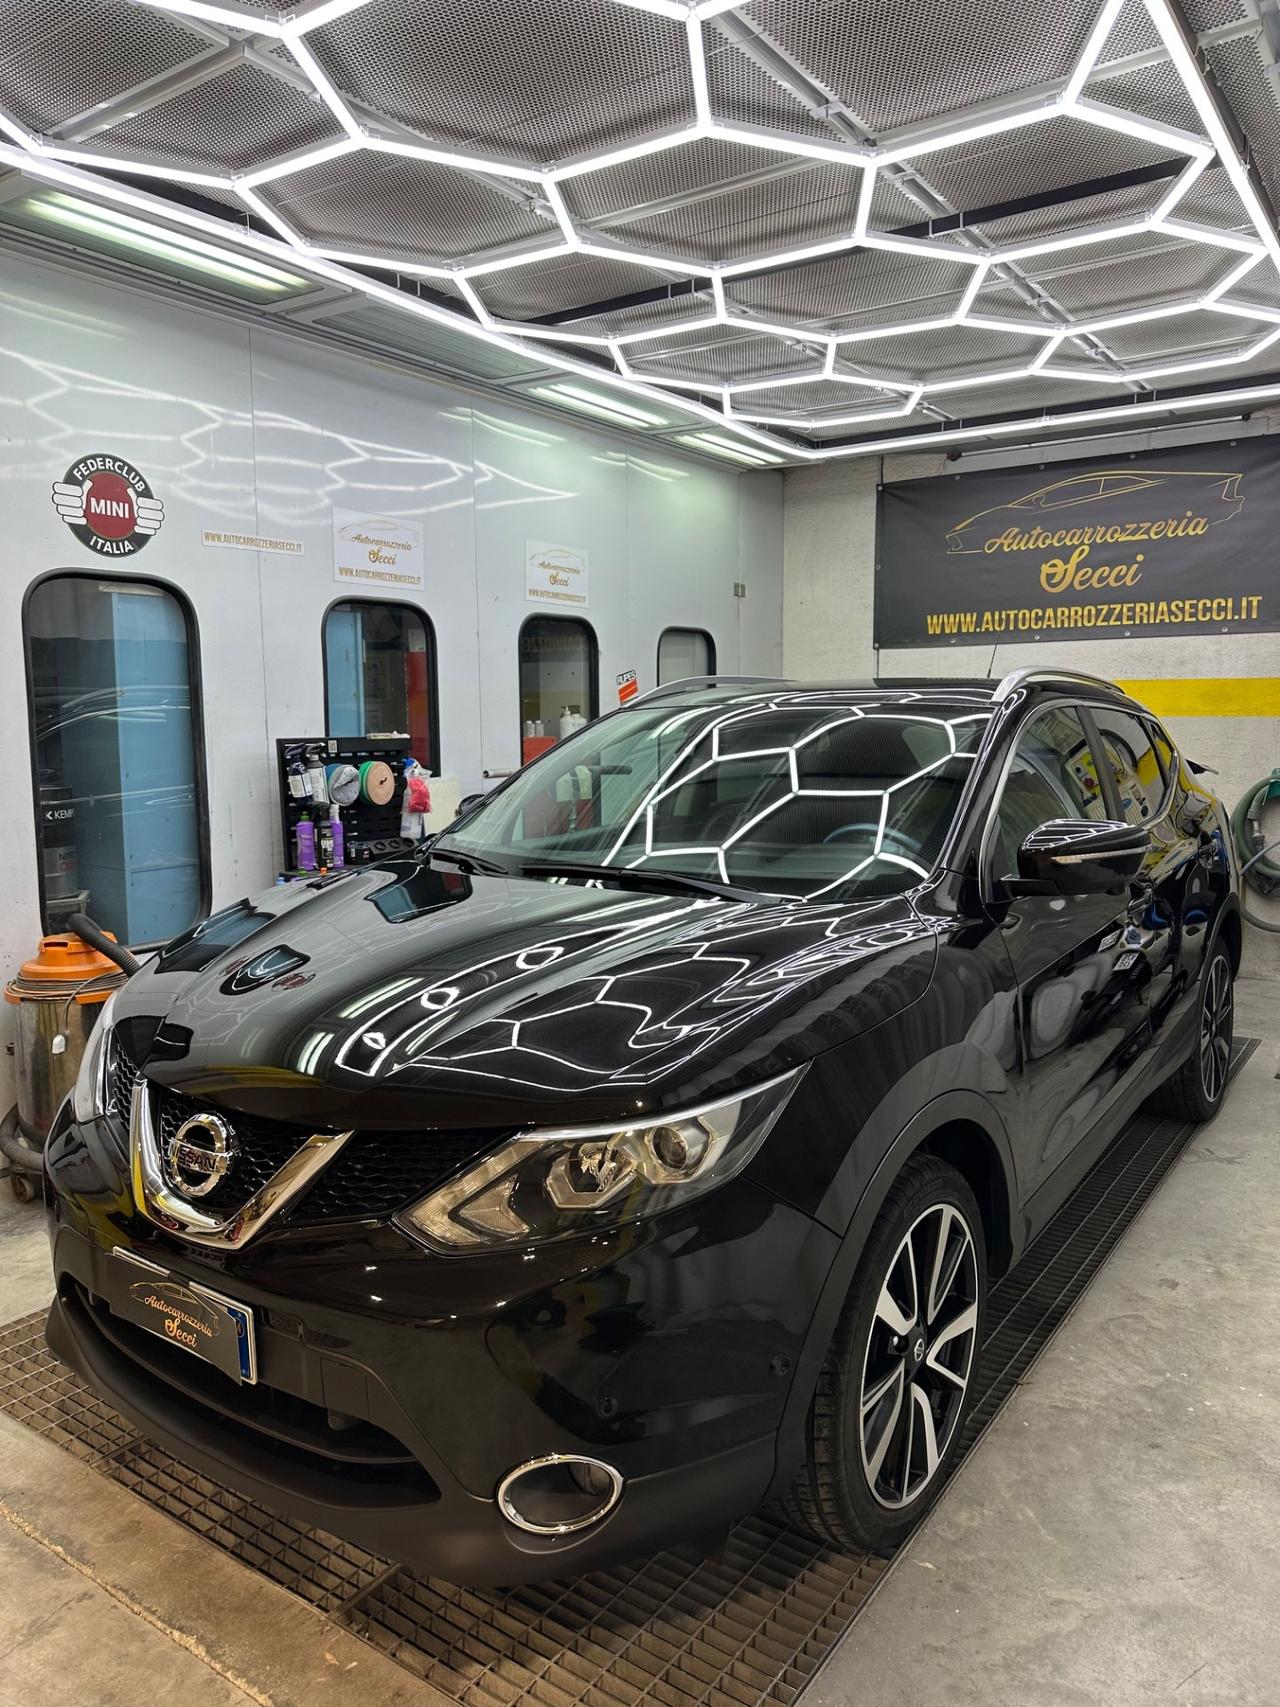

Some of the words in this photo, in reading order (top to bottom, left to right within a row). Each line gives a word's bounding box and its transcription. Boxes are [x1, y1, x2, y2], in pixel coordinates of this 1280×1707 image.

[73, 458, 145, 492] FEDERCLUB
[90, 497, 129, 519] MINI
[90, 535, 134, 554] ITALIA
[203, 531, 302, 552] WWW.AUTOCARROZZERIASECCI.IT
[985, 510, 1209, 553] Autocarrozzeria
[368, 547, 397, 565] Secci
[1040, 545, 1144, 593] Secci
[926, 595, 1263, 635] WWW.AUTOCARROZZERIASECCI.IT
[616, 669, 636, 686] RUPES
[144, 1295, 214, 1338] Autocarrozzeria
[165, 1319, 197, 1348] Secci
